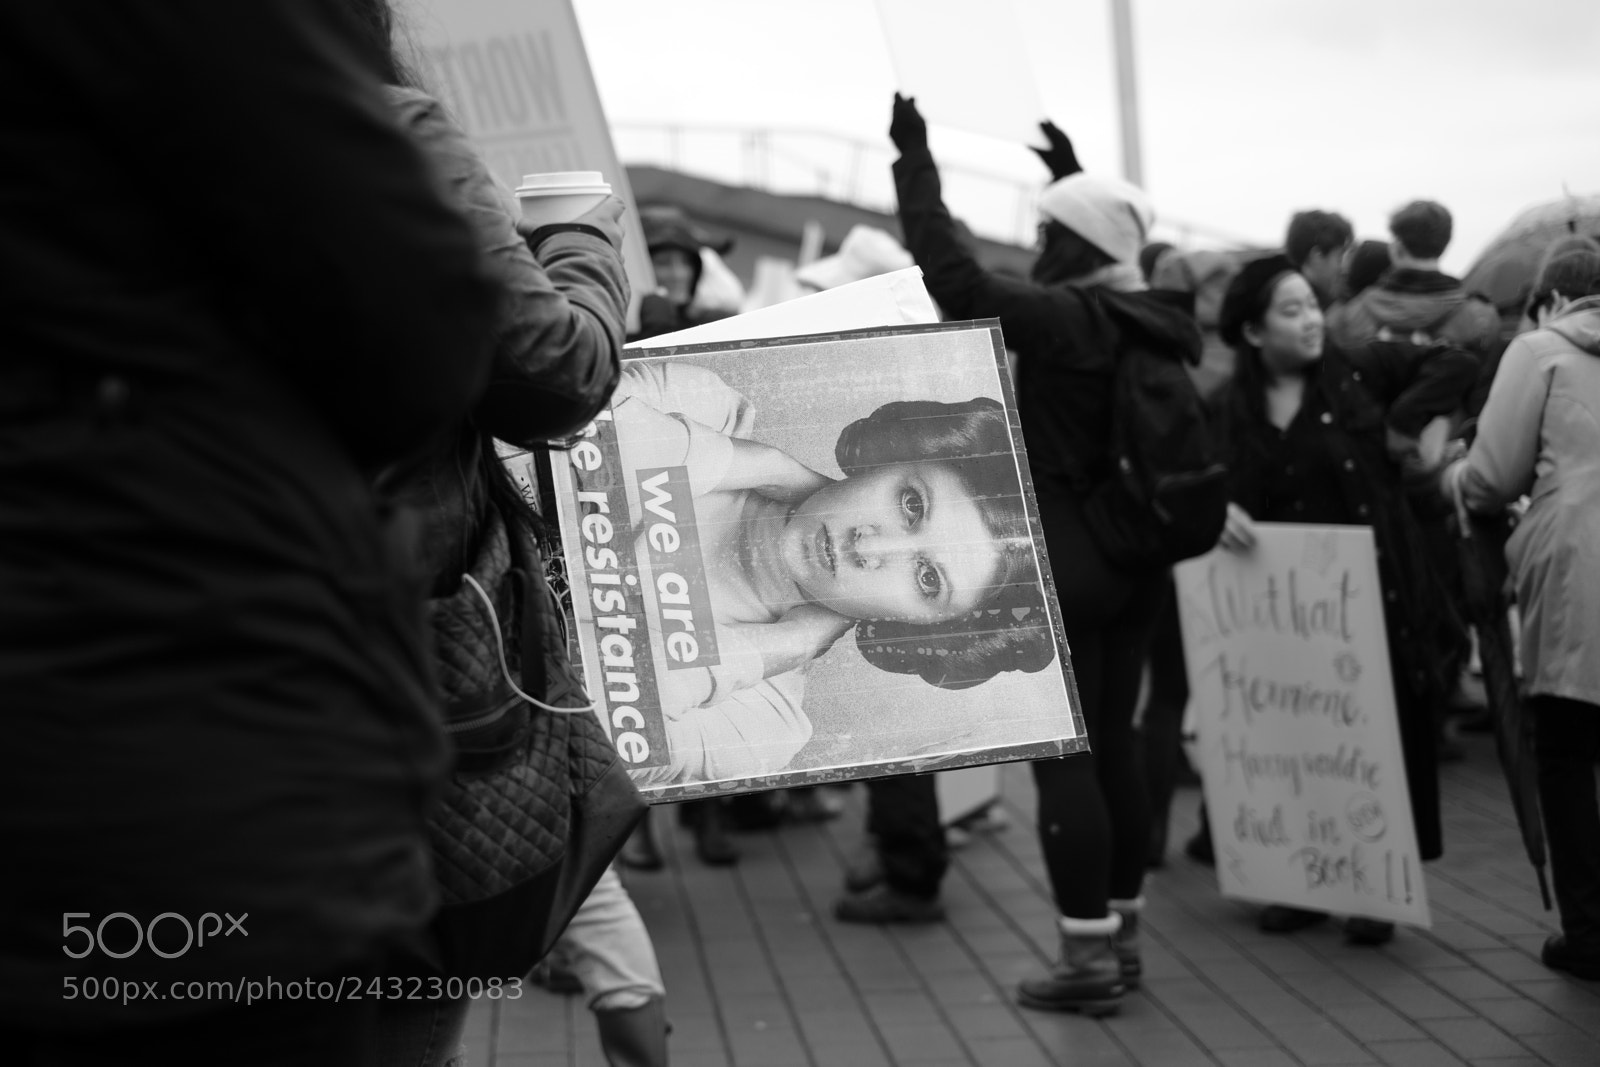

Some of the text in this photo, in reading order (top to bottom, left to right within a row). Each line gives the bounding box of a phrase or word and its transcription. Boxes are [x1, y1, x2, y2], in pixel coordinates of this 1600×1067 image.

[577, 490, 650, 764] resistance
[640, 470, 700, 663] we are
